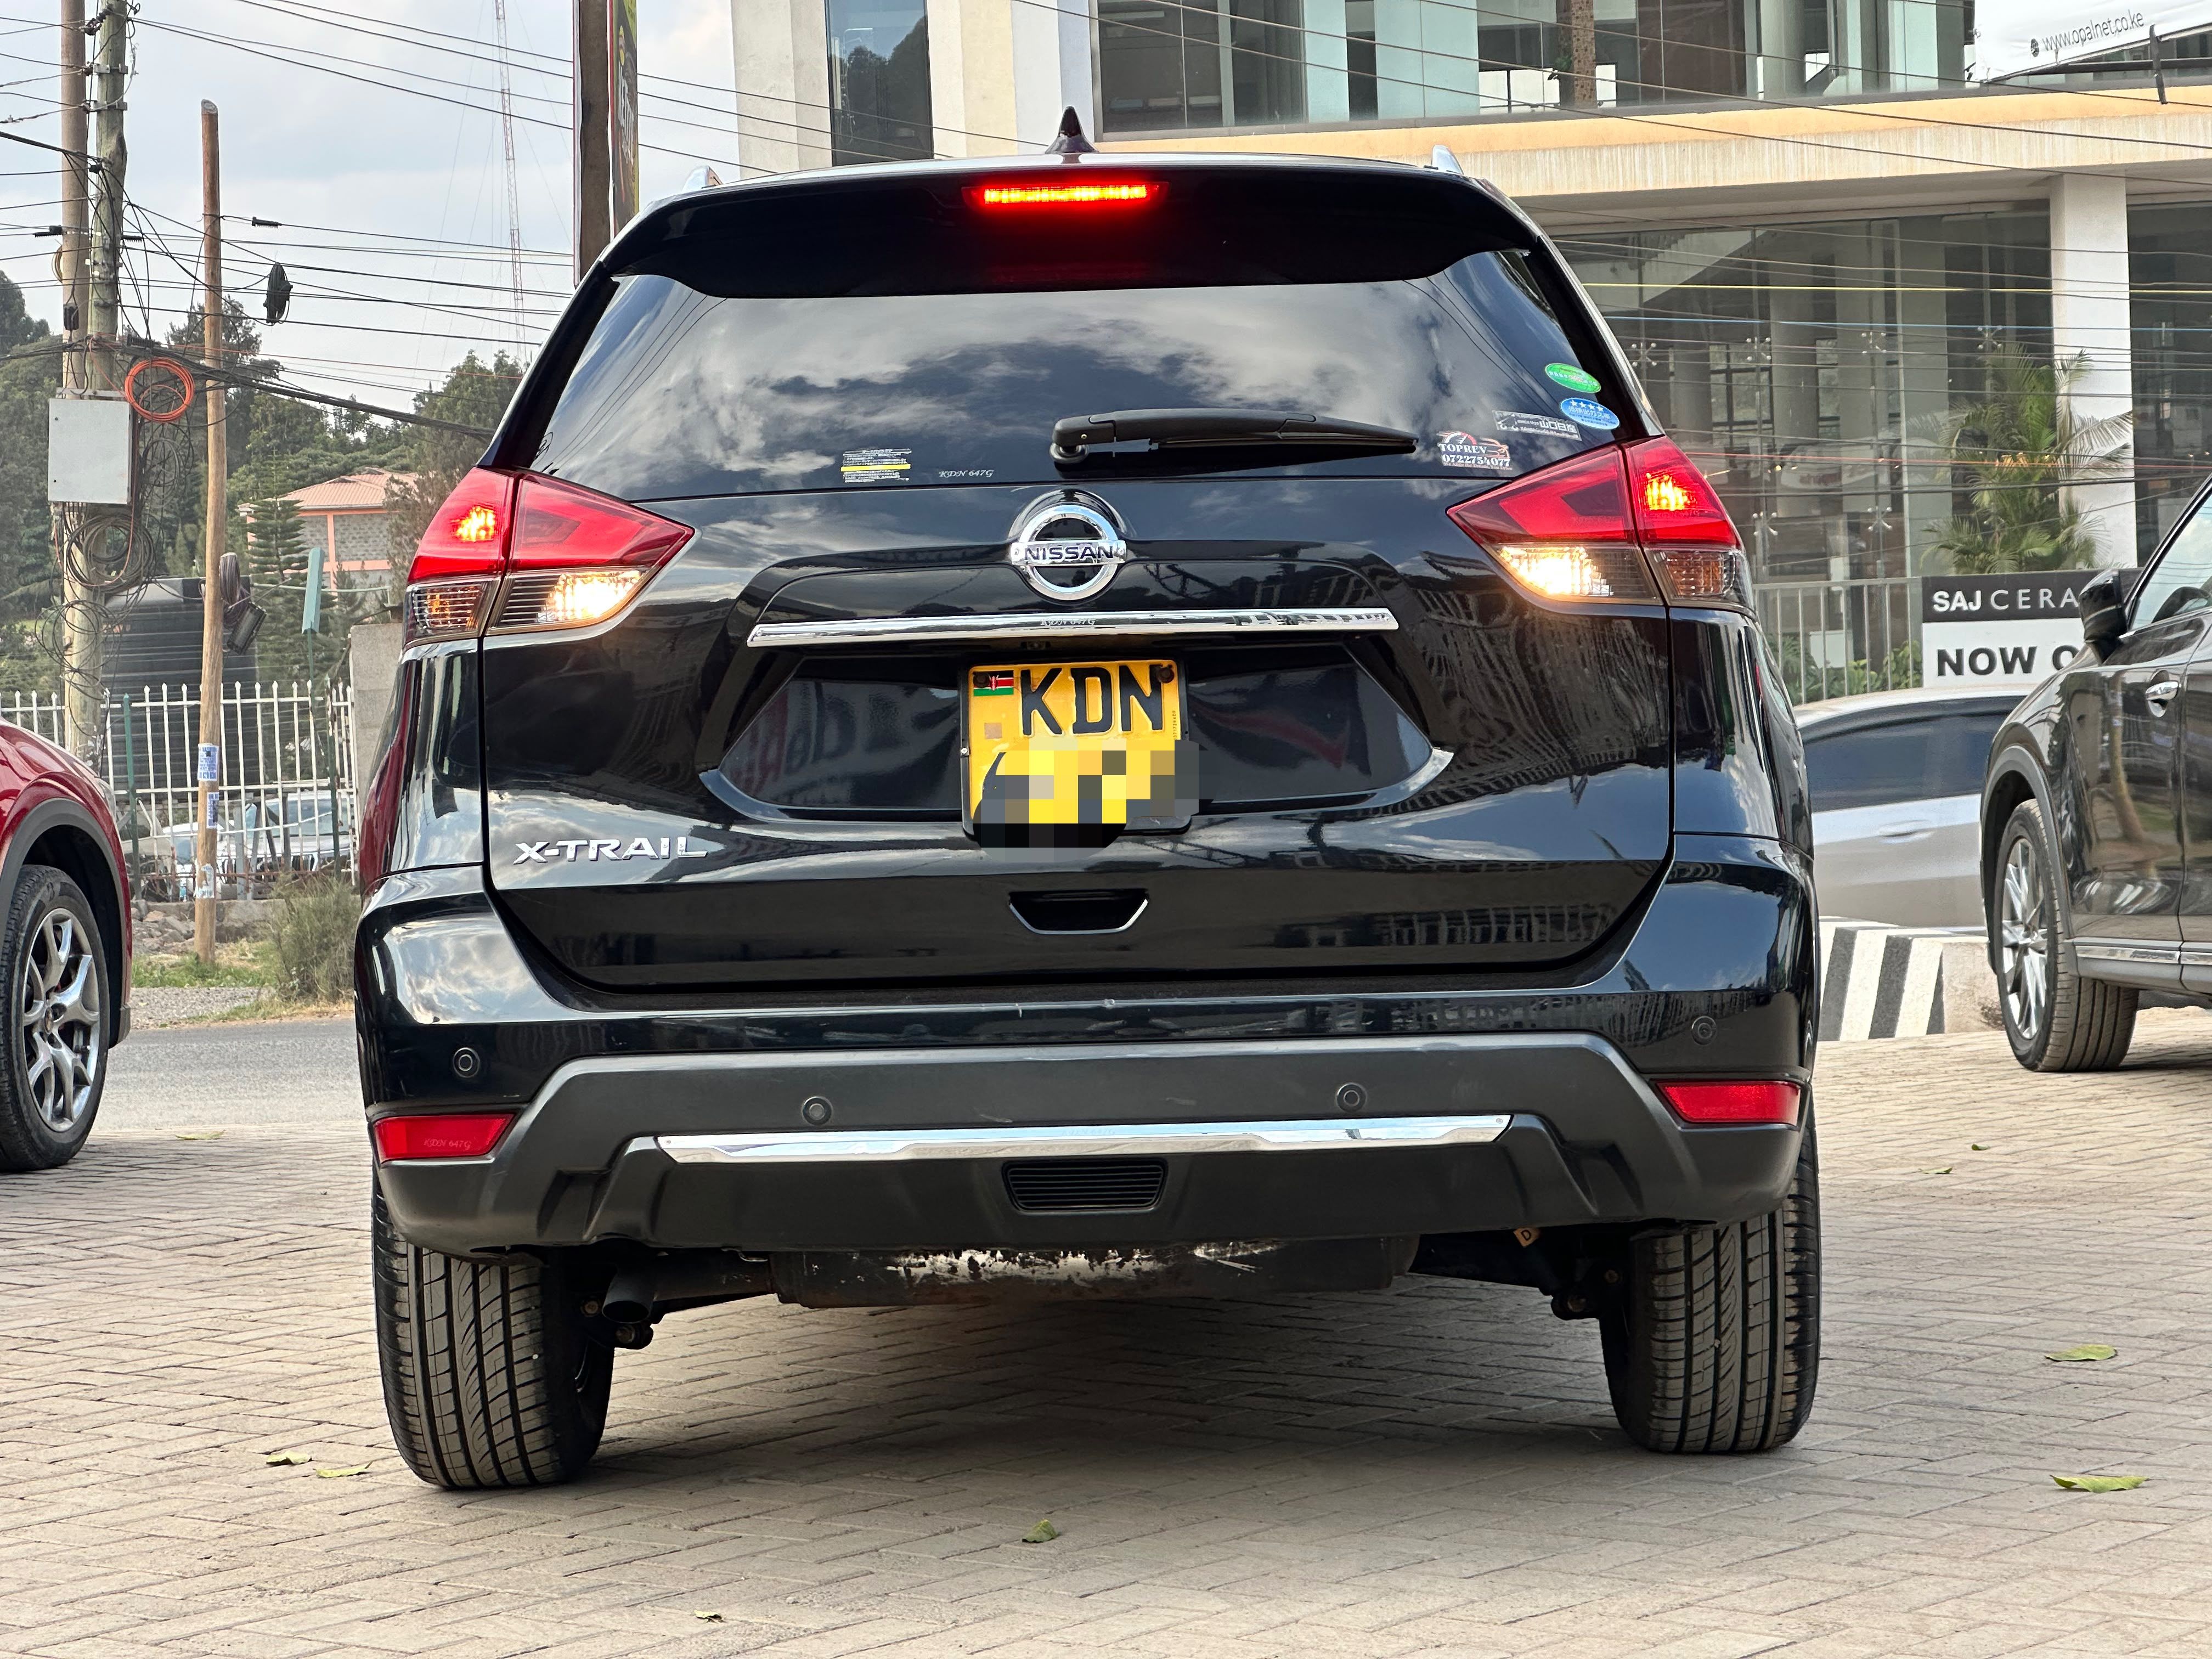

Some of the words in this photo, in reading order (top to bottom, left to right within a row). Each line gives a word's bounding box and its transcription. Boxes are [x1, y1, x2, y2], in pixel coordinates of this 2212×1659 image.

[2042, 9, 2145, 51] www.opalnet.co.ke
[1438, 443, 1487, 454] TOPREV
[1442, 454, 1510, 466] 0722754077
[1025, 545, 1114, 560] NISSAN
[1933, 590, 1982, 612] SAJ
[1990, 588, 2079, 610] CERA
[1937, 646, 2038, 676] NOW
[1020, 664, 1164, 735] KDN
[514, 837, 708, 865] X-TRAIL
[424, 1139, 447, 1147] KDN
[449, 1139, 472, 1150] 647G
